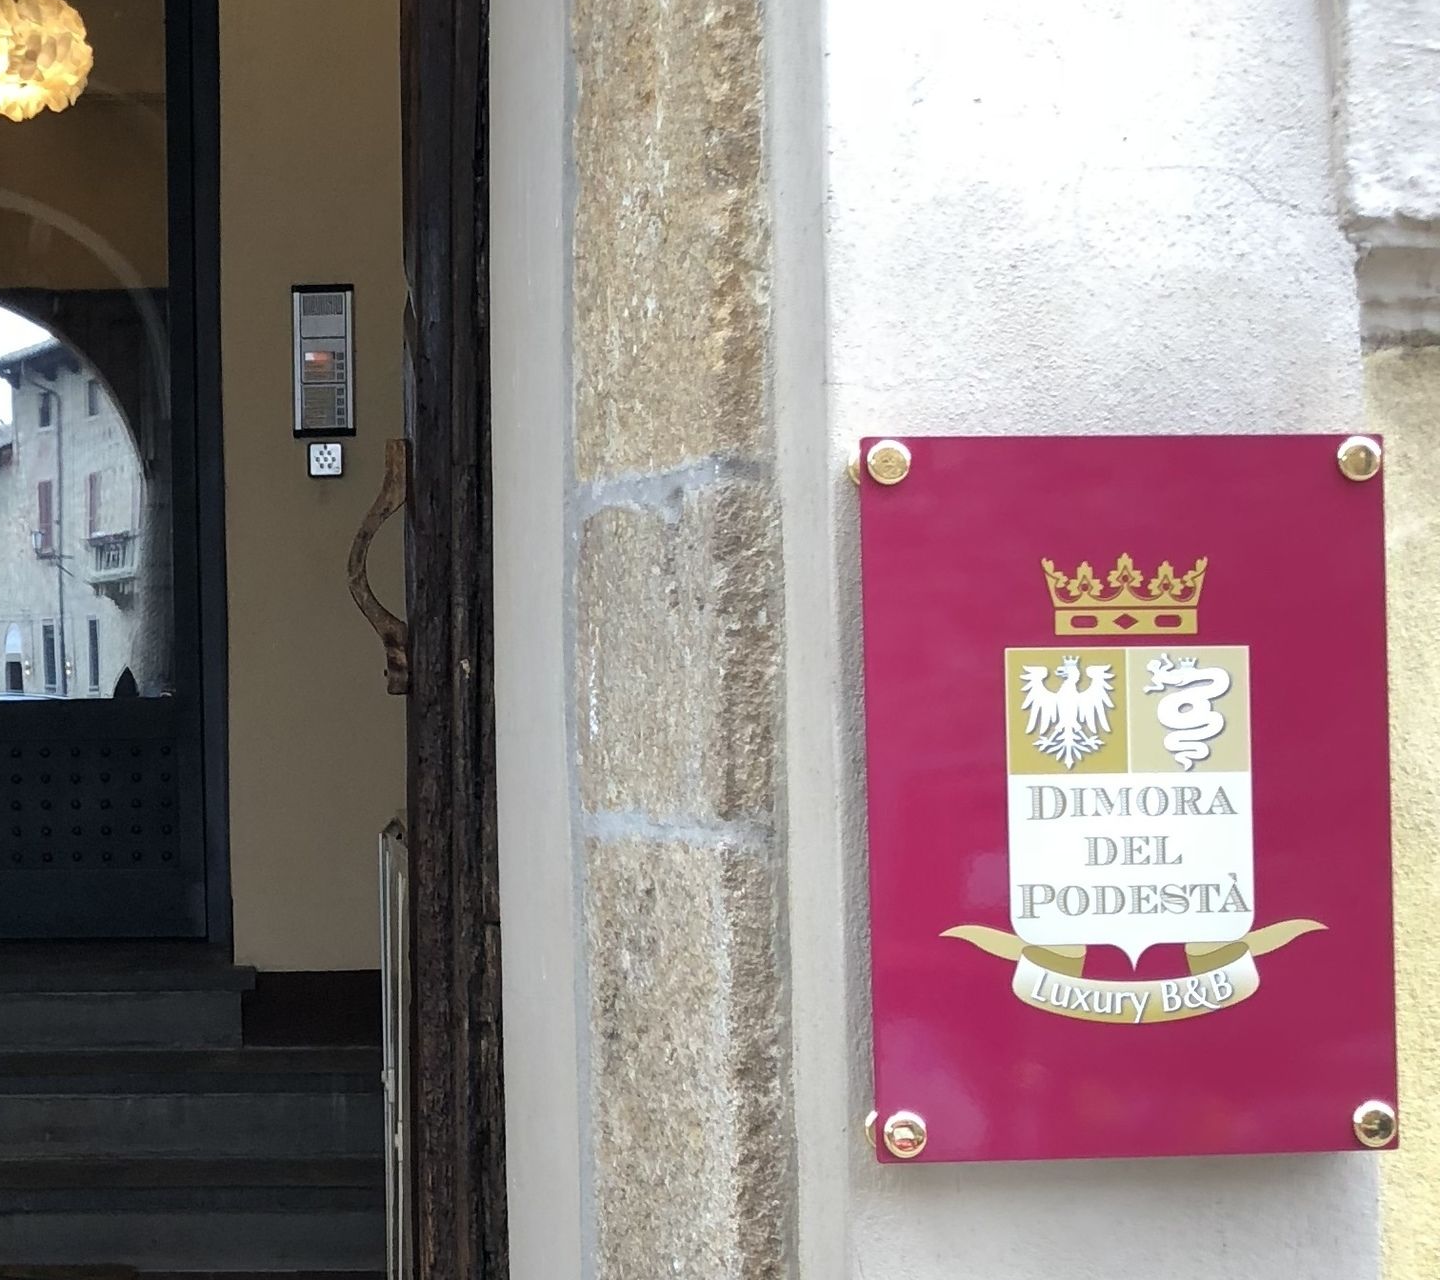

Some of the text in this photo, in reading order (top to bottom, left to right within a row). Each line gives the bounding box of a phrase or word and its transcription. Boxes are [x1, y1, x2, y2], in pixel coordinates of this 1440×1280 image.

[1026, 785, 1238, 821] DIMORA
[1084, 835, 1183, 866] DEL
[1016, 872, 1252, 920] PODESTÀ
[1031, 970, 1234, 1024] Luxury B&B
